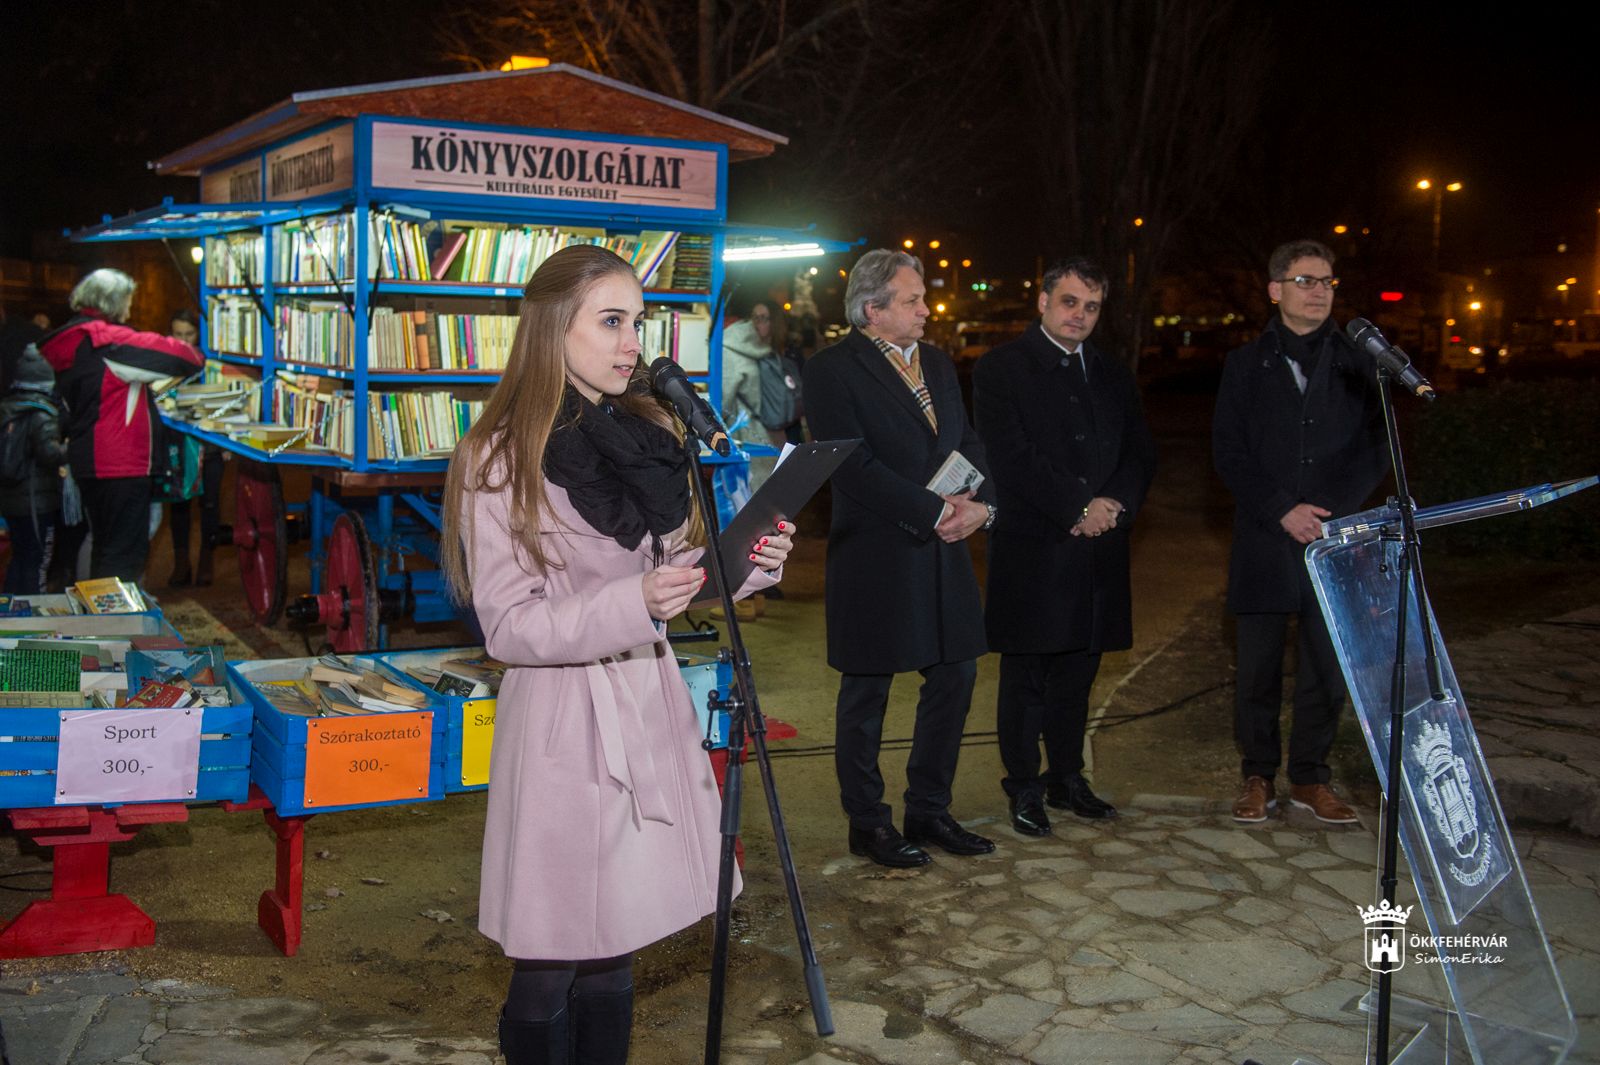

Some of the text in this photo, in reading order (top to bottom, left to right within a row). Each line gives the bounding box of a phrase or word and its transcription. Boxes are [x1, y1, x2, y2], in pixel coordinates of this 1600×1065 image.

[411, 132, 685, 190] KÖNYVSZOLGÁLAT
[558, 185, 618, 202] EGYESÜLET
[104, 725, 157, 743] Sport
[319, 725, 422, 745] Szórakoztató
[102, 759, 153, 776] 300,-
[348, 758, 390, 773] 300,-
